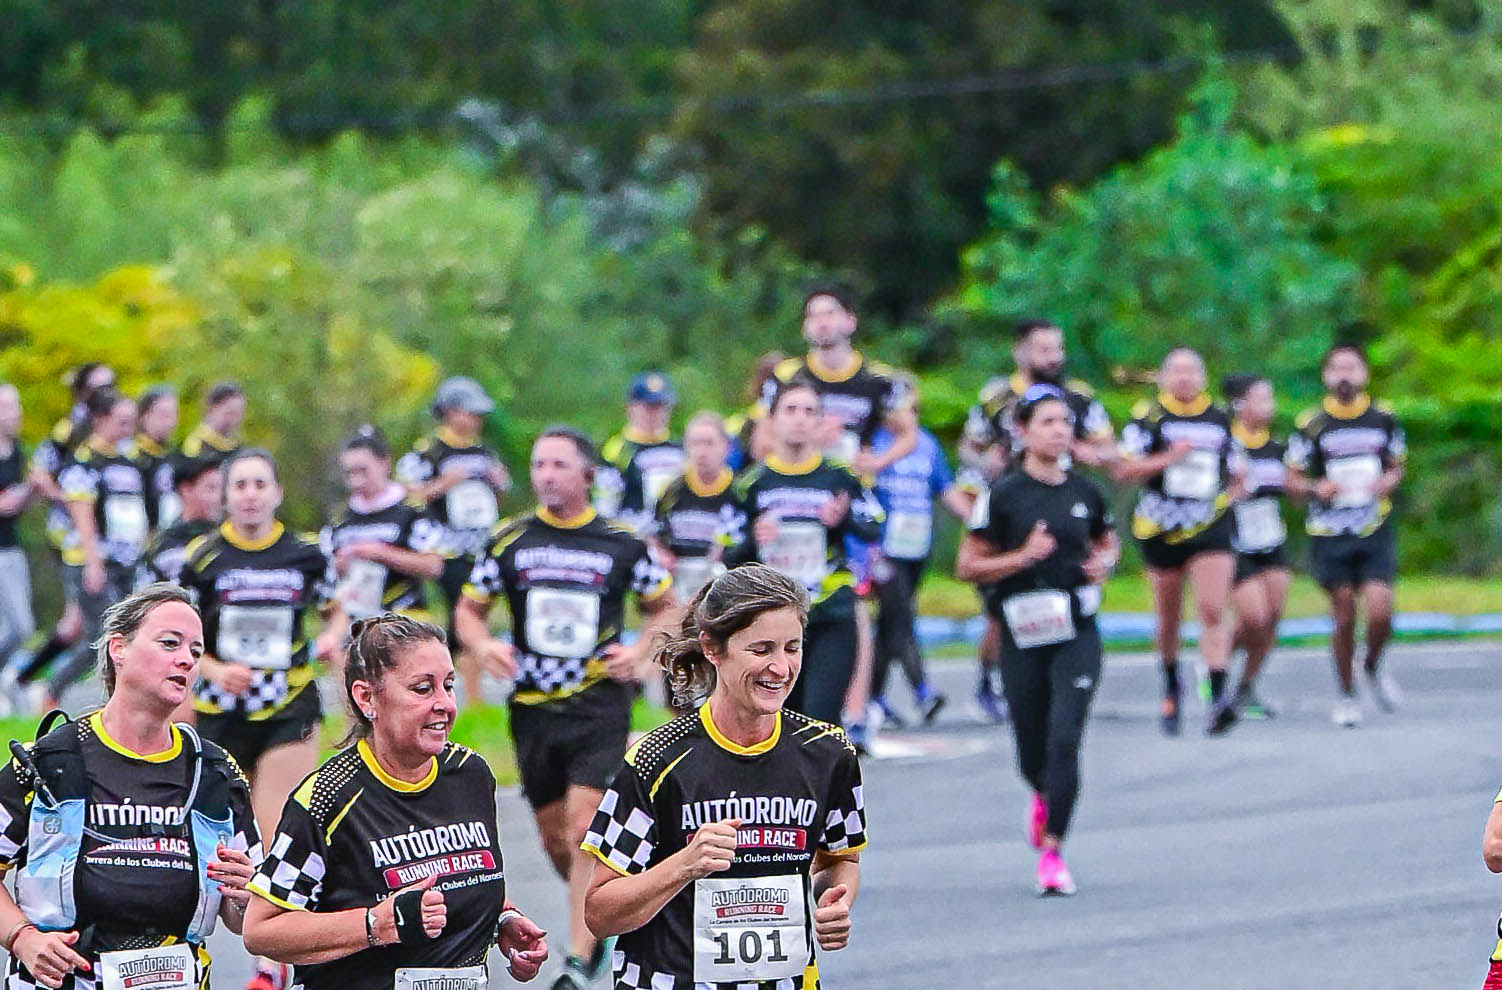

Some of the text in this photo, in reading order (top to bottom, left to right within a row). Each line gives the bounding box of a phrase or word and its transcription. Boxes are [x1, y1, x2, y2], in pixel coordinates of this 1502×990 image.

[680, 791, 818, 830] AUTÓDROMO
[369, 821, 491, 868] AUTÓDROMO
[763, 829, 797, 848] RACE
[113, 856, 126, 867] de
[126, 857, 141, 867] los
[396, 853, 485, 884] RUNNING RACE
[743, 852, 771, 863] Clubes
[772, 852, 786, 862] del
[711, 884, 790, 908] AUTÓDROMO
[713, 929, 789, 965] 101
[118, 954, 187, 979] AUTÓDROMO
